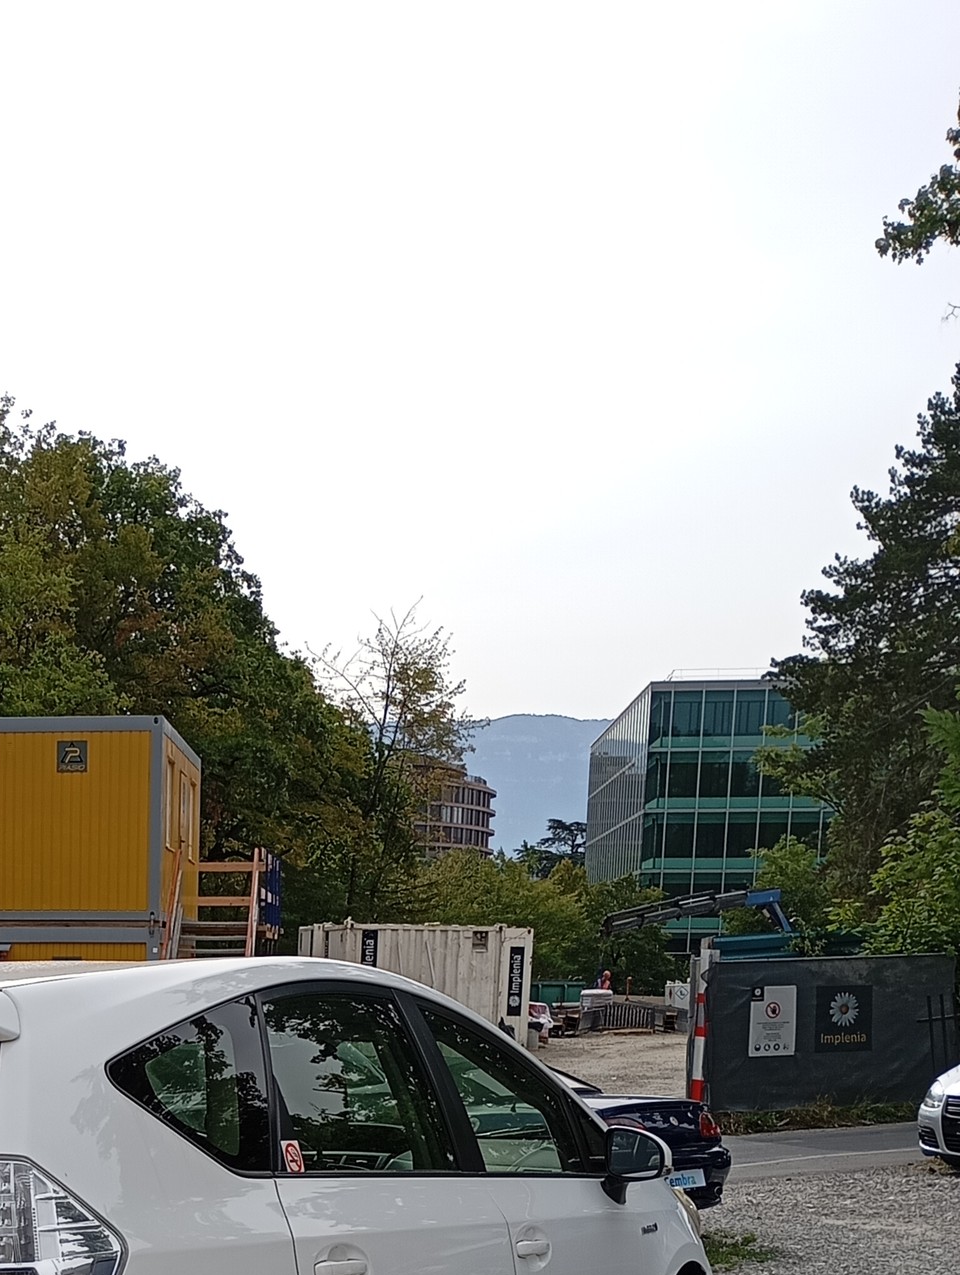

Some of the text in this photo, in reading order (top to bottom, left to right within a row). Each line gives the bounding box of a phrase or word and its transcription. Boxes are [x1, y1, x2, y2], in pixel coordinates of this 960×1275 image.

[363, 938, 374, 965] lenia
[510, 953, 522, 994] Implenia
[820, 1032, 867, 1045] Implenia
